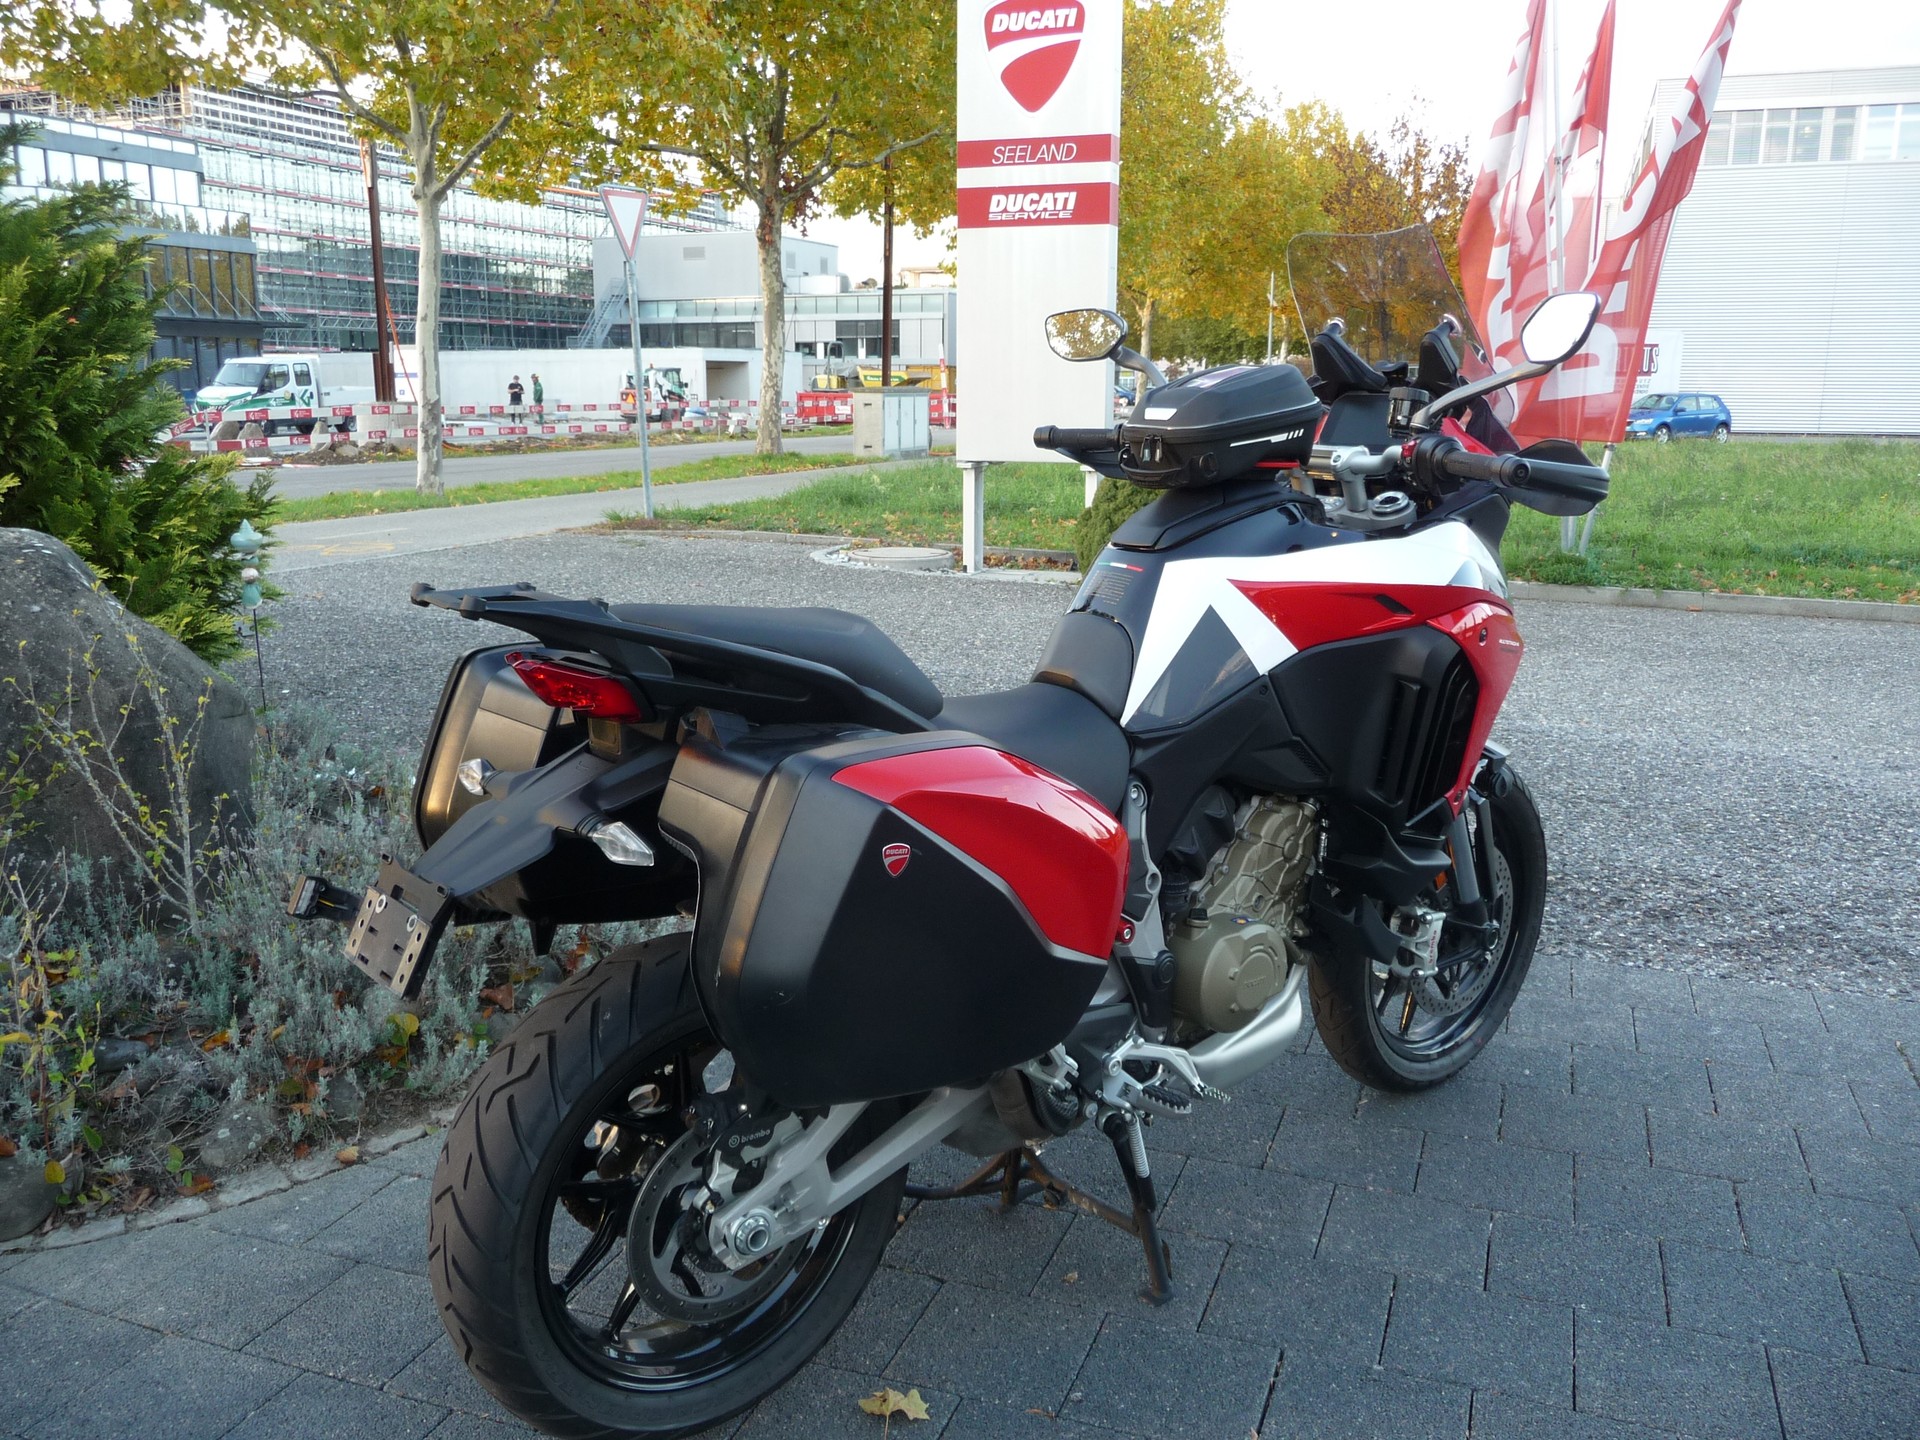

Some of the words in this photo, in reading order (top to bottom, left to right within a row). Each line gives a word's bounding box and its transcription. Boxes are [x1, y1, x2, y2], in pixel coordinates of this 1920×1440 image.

[991, 8, 1077, 33] DUCATI
[991, 142, 1077, 165] SEELAND
[988, 191, 1077, 213] DUCATI
[988, 210, 1073, 221] SERVICE
[741, 1129, 771, 1143] brembo
